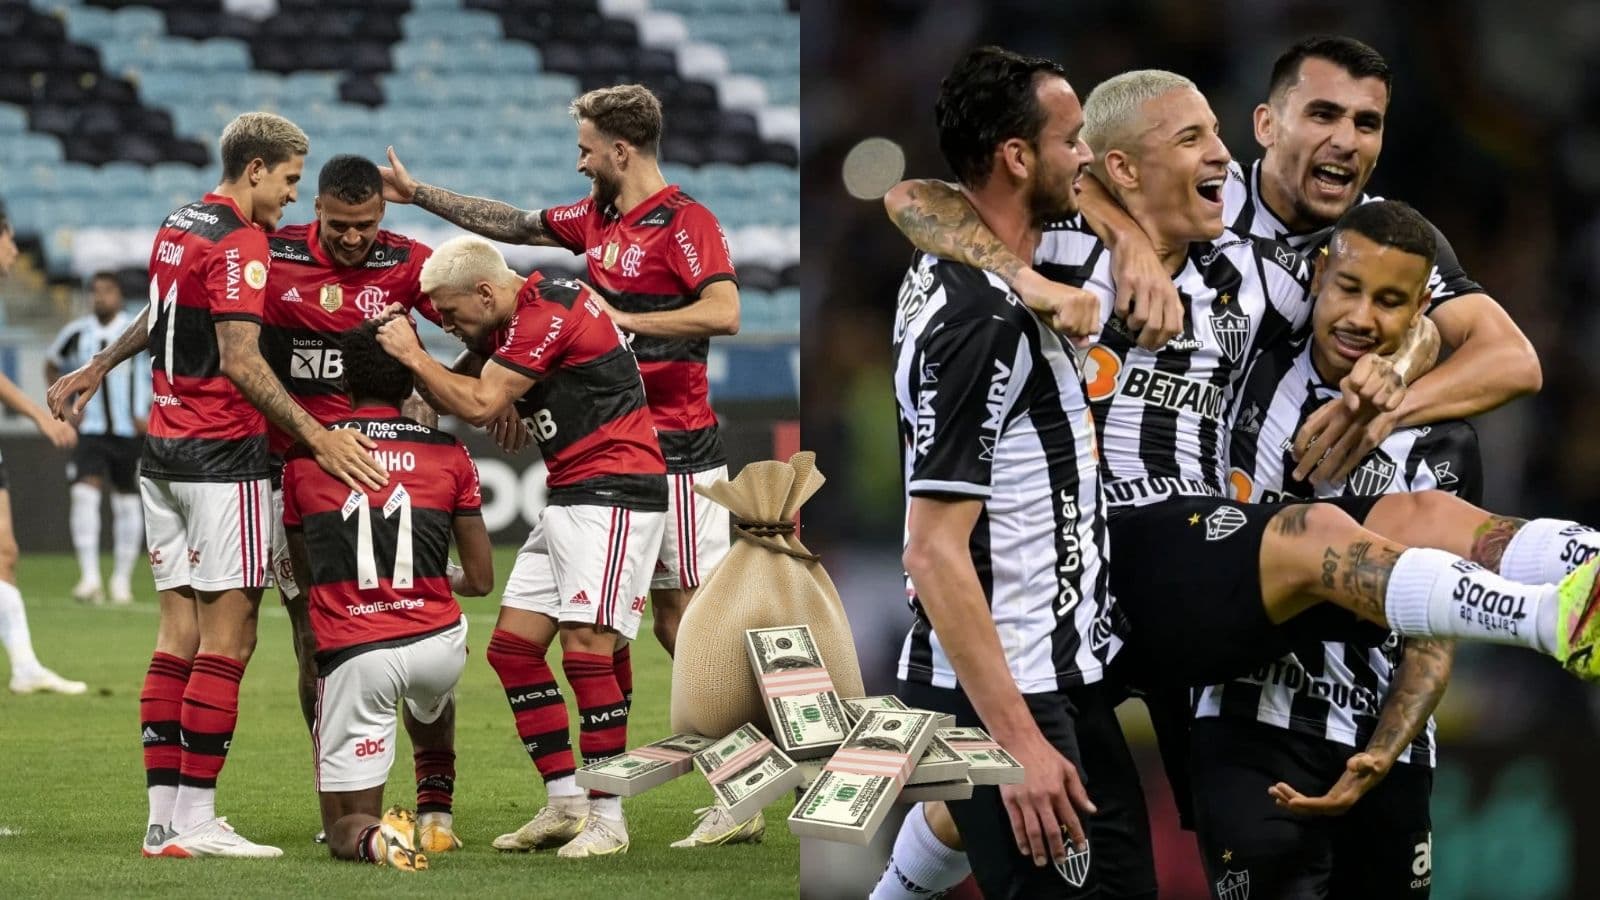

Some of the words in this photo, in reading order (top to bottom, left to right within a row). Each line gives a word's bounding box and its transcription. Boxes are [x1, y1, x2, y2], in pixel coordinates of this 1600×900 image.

[156, 240, 184, 266] PEDRO
[675, 229, 702, 277] HAVAN
[225, 248, 240, 300] HAVAN
[1215, 319, 1246, 329] CAM
[292, 338, 323, 347] banco
[981, 359, 1011, 431] MRV
[1120, 366, 1225, 419] BETANO
[367, 421, 431, 434] mercado
[368, 430, 398, 440] livre
[917, 390, 937, 456] MRV
[341, 482, 414, 590] 11
[1059, 489, 1080, 572] buser
[346, 598, 425, 616] TotalEnergs
[1452, 576, 1527, 619] TODOS
[1460, 605, 1472, 624] de
[355, 738, 386, 757] abc
